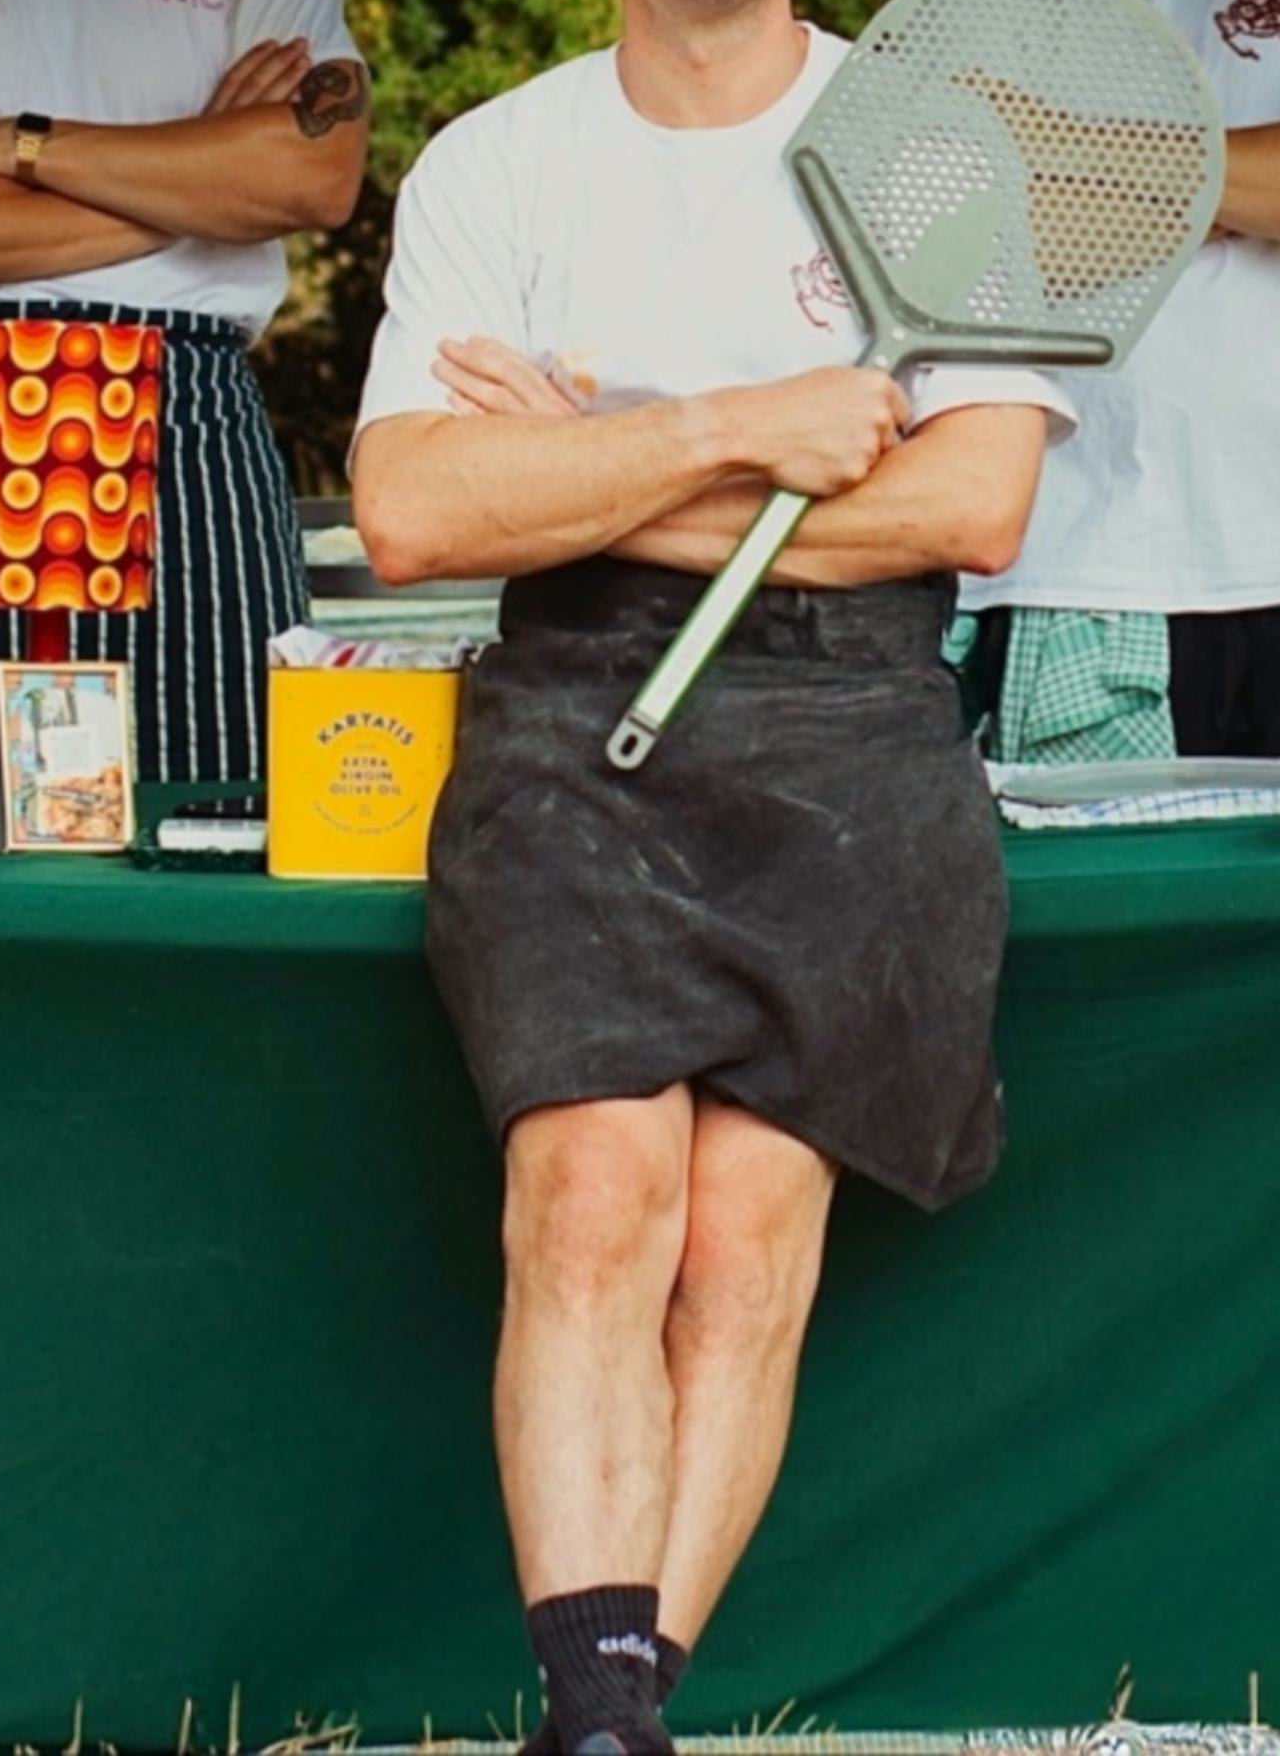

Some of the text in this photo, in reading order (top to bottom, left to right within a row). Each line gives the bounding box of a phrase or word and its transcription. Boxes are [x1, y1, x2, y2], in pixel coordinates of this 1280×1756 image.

[316, 711, 416, 746] KARTATIS
[341, 756, 389, 769] EXTRA
[340, 770, 394, 782] VIRGIN
[328, 783, 403, 797] OLIVE OIL
